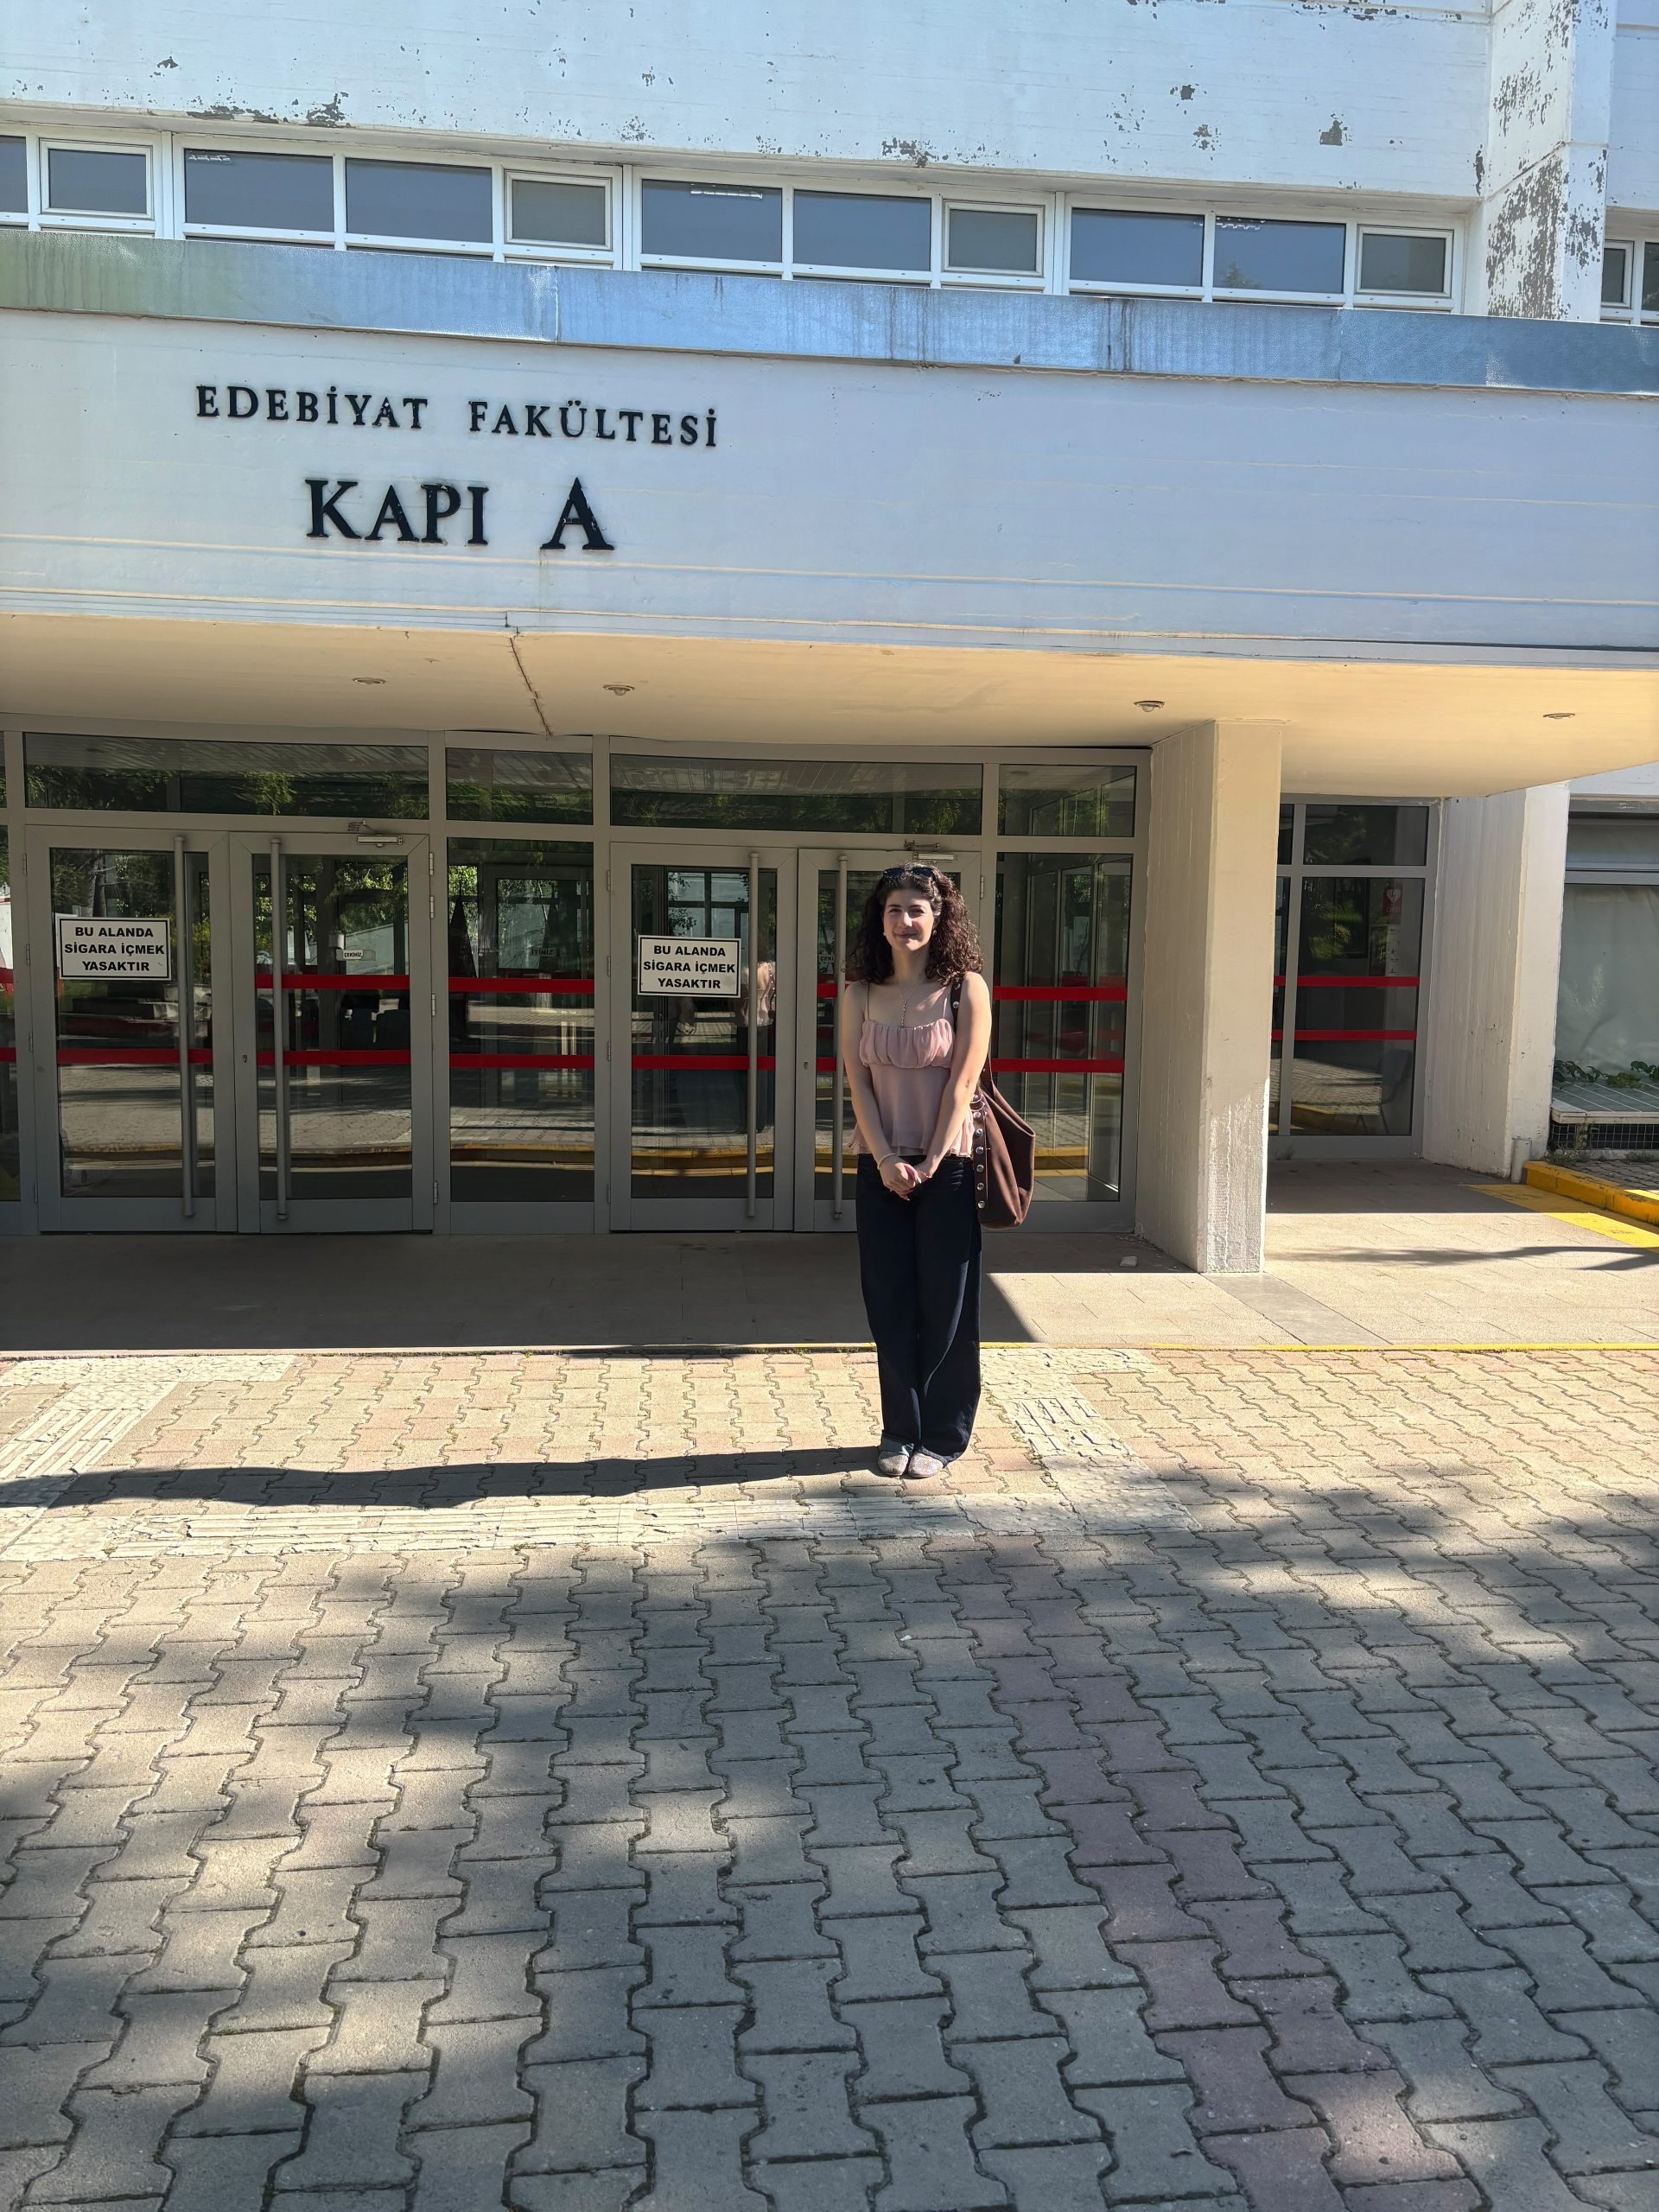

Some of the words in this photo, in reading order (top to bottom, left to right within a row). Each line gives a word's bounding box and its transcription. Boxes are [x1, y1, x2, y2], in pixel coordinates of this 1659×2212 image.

[195, 385, 429, 429] EDEBİYAT
[469, 399, 717, 448] FAKÜLTESİ
[304, 479, 490, 546] KAPI
[539, 476, 615, 550] A
[75, 926, 94, 937] BU
[99, 927, 154, 938] ALANDA
[64, 942, 117, 954] SİGARA
[121, 943, 165, 957] İÇMEK
[653, 945, 671, 955] BU
[675, 946, 726, 957] ALANDA
[82, 961, 149, 971] YASAKTIR
[643, 959, 691, 972] SİGARA
[695, 961, 735, 975] İÇMEK
[658, 978, 721, 988] YASAKTIR
